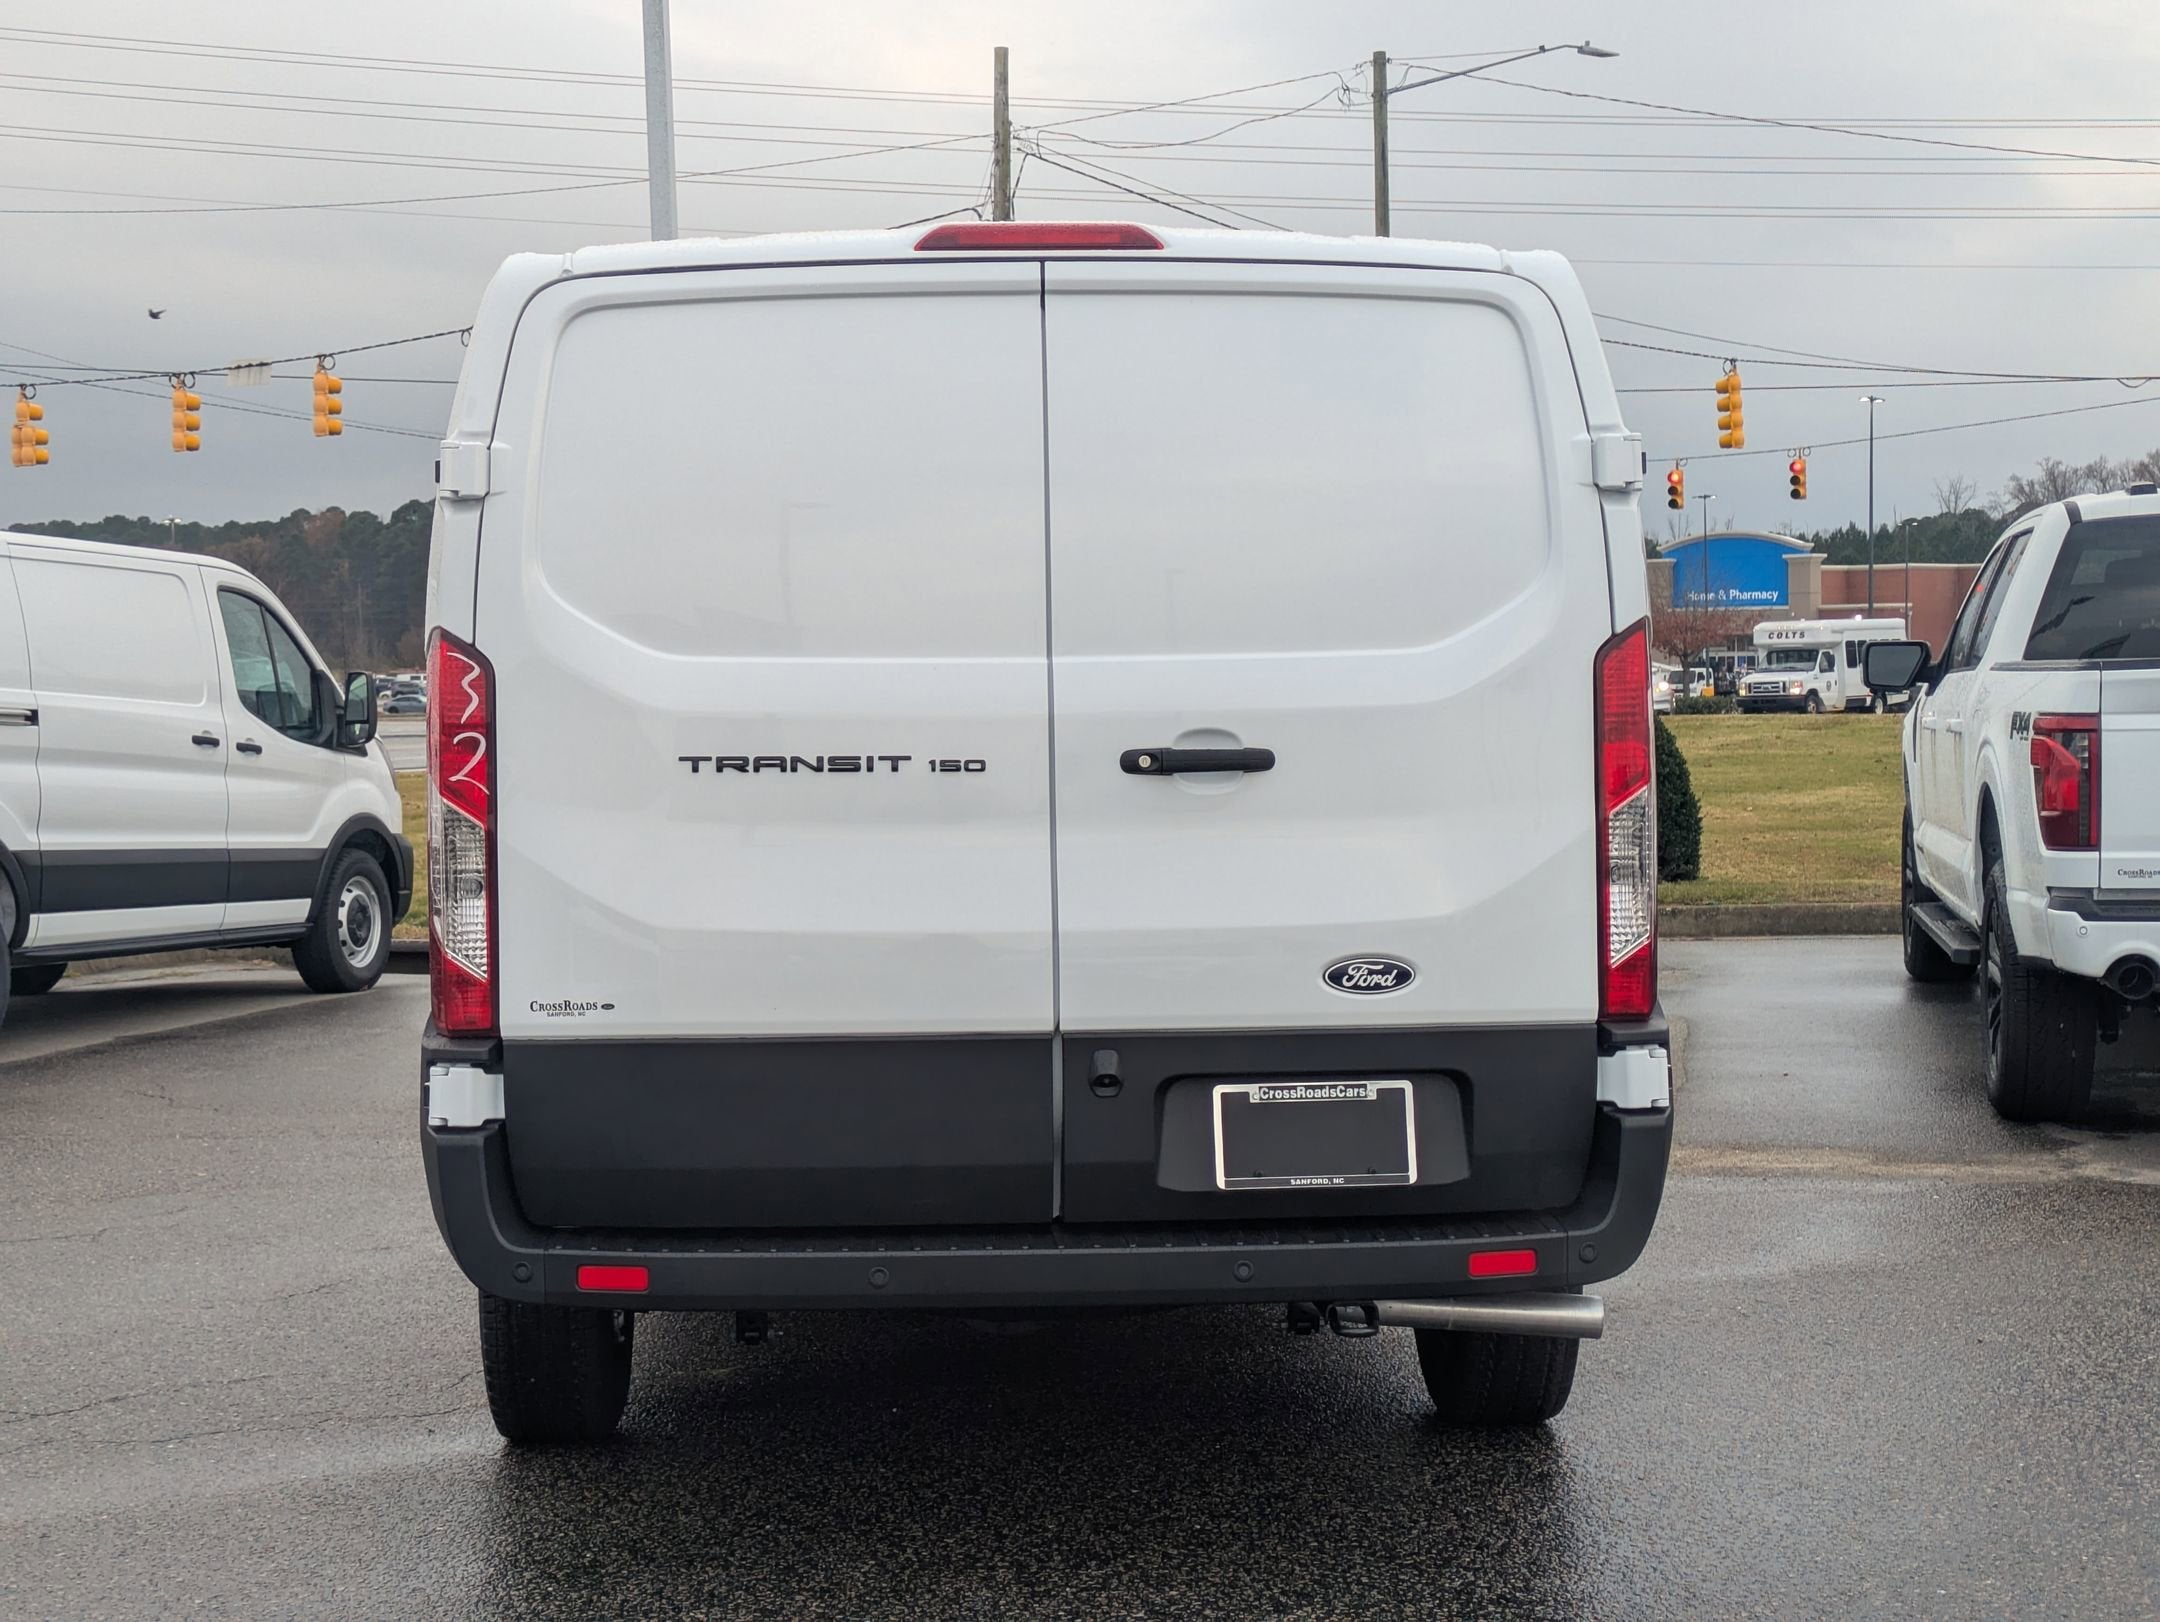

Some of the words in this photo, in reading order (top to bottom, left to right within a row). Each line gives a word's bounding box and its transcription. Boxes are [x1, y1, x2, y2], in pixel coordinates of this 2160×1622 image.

[1687, 590, 1716, 601] Home
[1718, 589, 1727, 601] &
[1729, 589, 1779, 602] Pharmacy
[1768, 631, 1806, 640] COLTS
[2010, 711, 2032, 740] FX4
[678, 755, 912, 774] TRANSIT
[928, 759, 986, 773] 150
[1342, 963, 1398, 987] Ford
[1260, 1085, 1366, 1099] CrossRoadsCars
